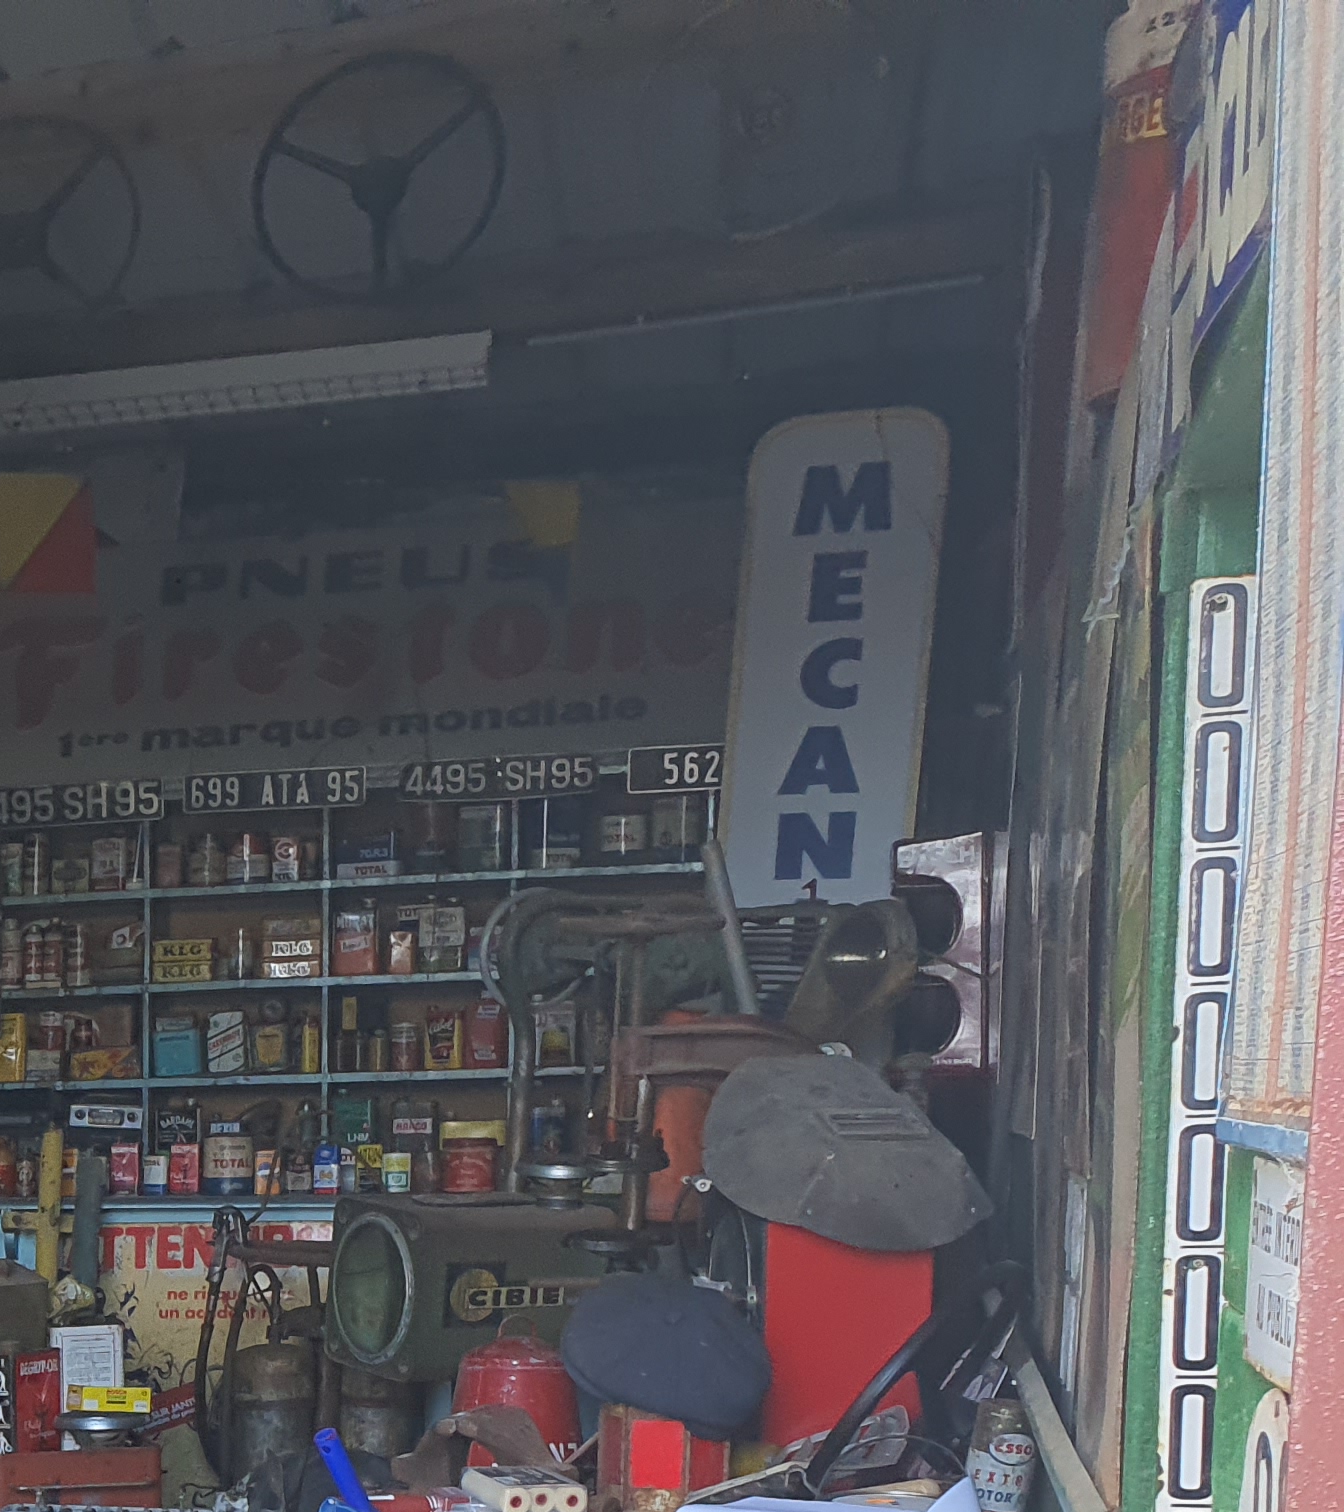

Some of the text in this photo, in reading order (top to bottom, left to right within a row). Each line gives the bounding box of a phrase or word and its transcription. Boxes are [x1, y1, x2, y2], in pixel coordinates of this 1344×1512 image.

[161, 539, 544, 607] PNEUS
[141, 714, 362, 757] marque
[380, 691, 647, 737] mondiale
[405, 763, 486, 796] 4495
[662, 752, 720, 785] 562
[190, 775, 242, 808] 699
[326, 770, 361, 804] 95
[162, 943, 201, 957] KLG
[212, 1157, 251, 1169] TOTAL
[159, 1308, 181, 1319] un
[977, 1488, 1013, 1503] OTOR
